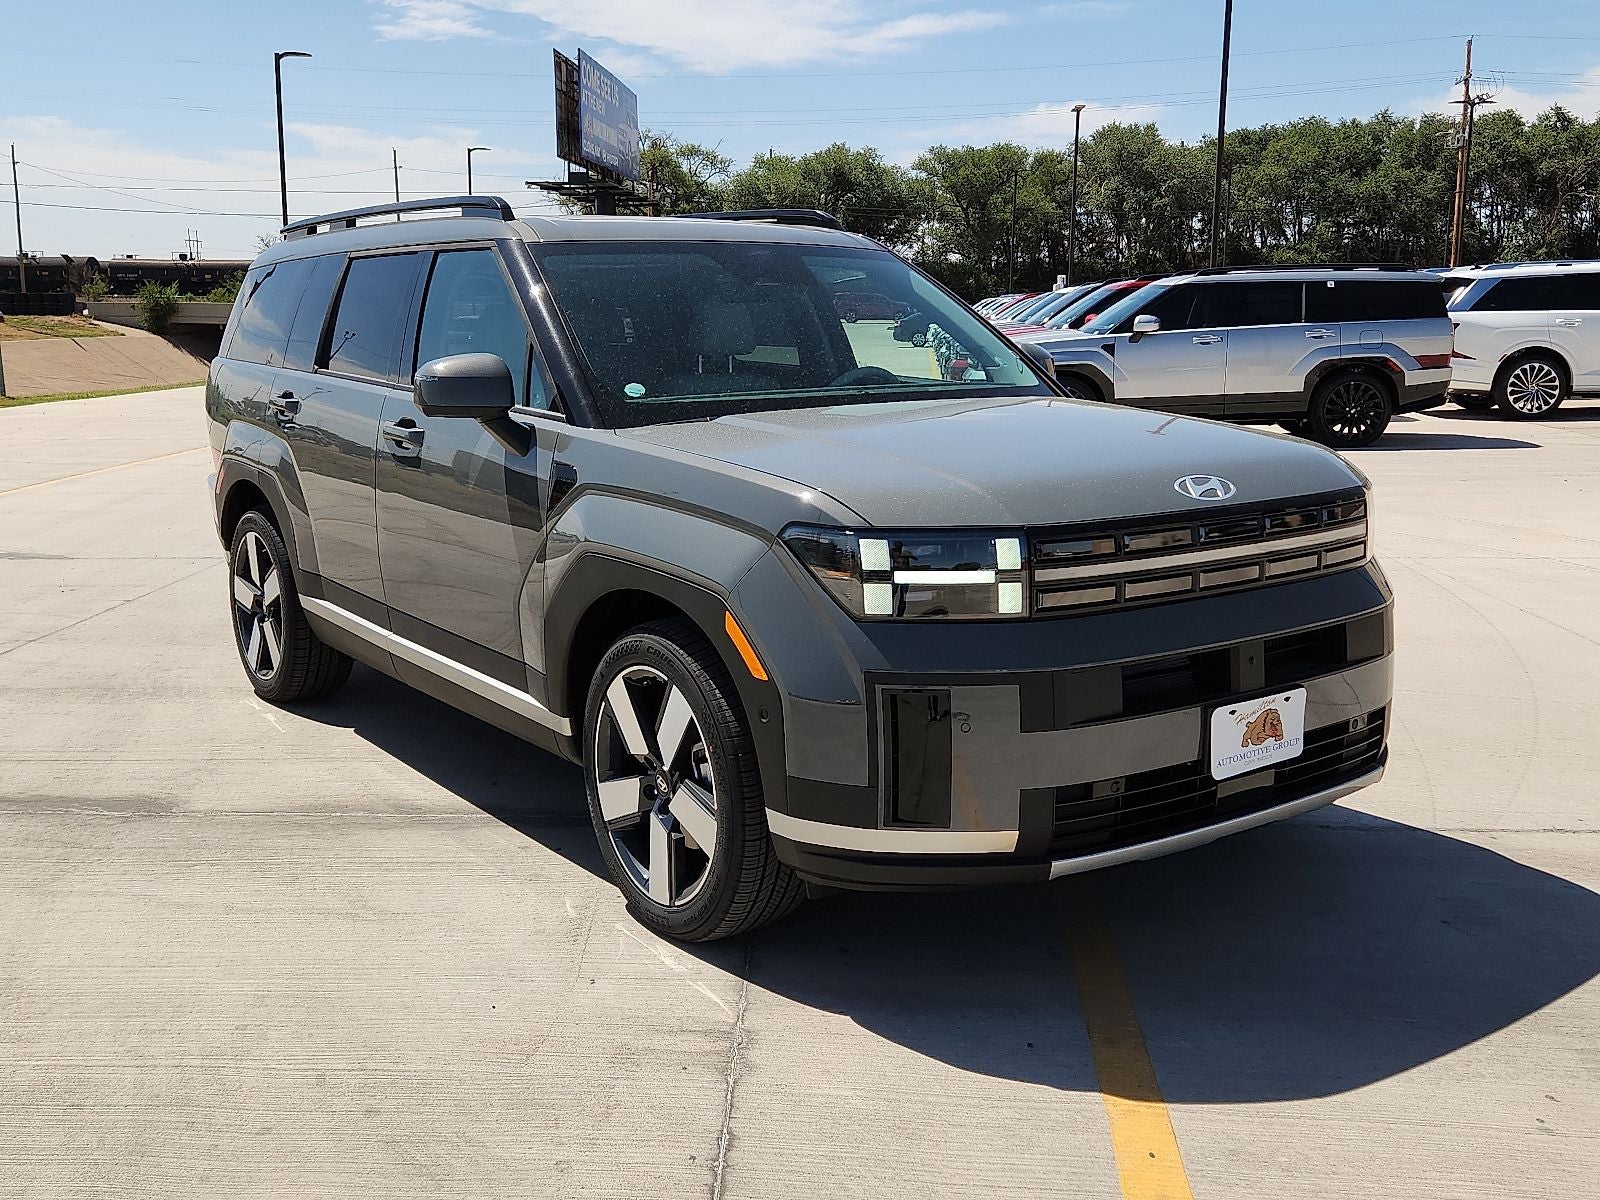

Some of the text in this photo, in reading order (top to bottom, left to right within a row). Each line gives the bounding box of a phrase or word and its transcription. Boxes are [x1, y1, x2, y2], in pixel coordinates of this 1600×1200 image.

[581, 60, 619, 108] COME SEE US
[1217, 746, 1271, 768] AUTOMOTIVE
[1272, 737, 1300, 752] GROUP
